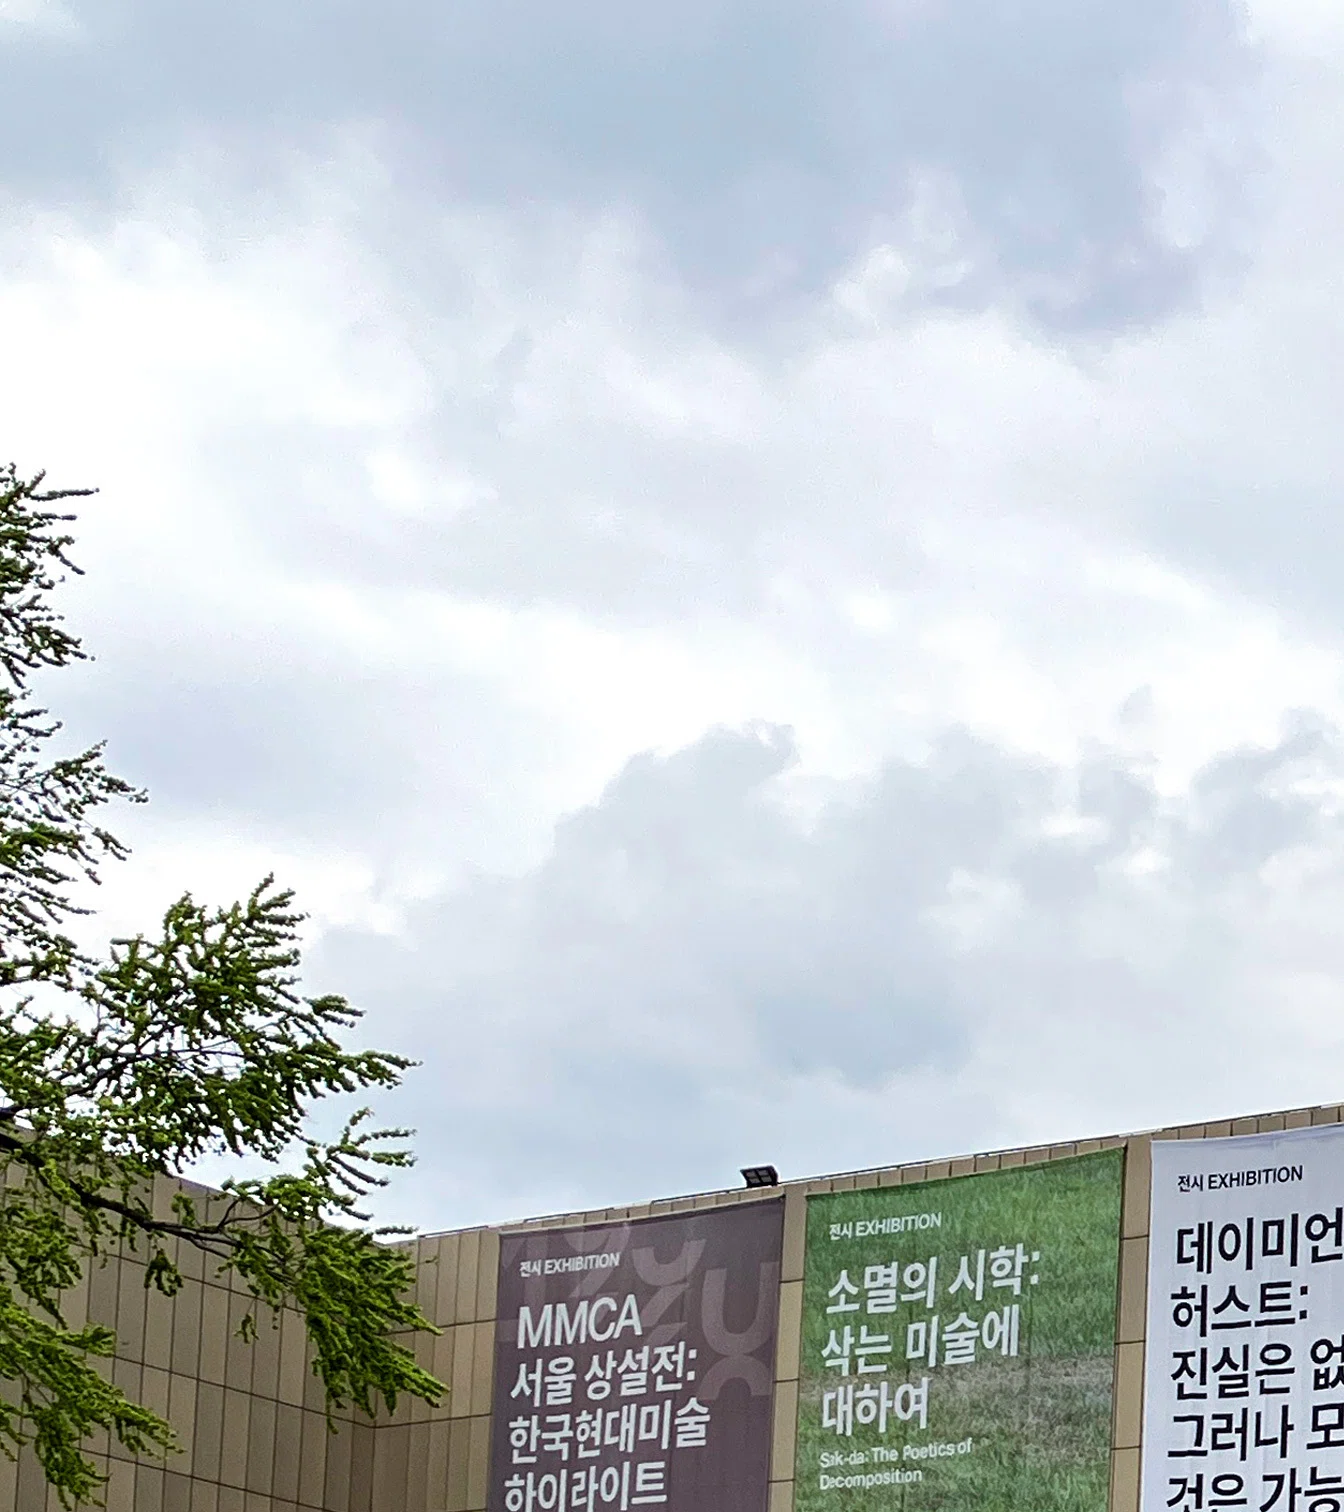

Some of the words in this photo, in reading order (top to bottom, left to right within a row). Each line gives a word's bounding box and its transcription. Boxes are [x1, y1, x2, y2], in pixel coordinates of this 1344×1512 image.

[1178, 1173, 1204, 1192] 전시
[1208, 1166, 1303, 1190] EXHIBITION
[829, 1224, 852, 1241] 전시
[856, 1213, 942, 1237] EXHIBITION
[1177, 1207, 1344, 1274] 데이미언
[520, 1260, 541, 1277] 전시
[544, 1252, 620, 1274] EXHIBITION
[827, 1256, 937, 1315] 소멸의
[948, 1243, 1040, 1300] 시학:
[517, 1293, 643, 1348] MMCA
[1171, 1281, 1308, 1338] 허스트:
[821, 1324, 892, 1376] 삭는
[906, 1305, 1019, 1368] 미술에
[510, 1357, 577, 1407] 서울
[585, 1342, 698, 1399] 상설전:
[1171, 1343, 1295, 1401] 진실은
[509, 1397, 711, 1464] 한국현대미술
[822, 1377, 930, 1436] 대하여
[1167, 1405, 1294, 1461] 그러나
[872, 1447, 898, 1463] The
[902, 1441, 954, 1461] Poetics
[957, 1438, 973, 1455] of
[820, 1469, 922, 1490] Decomposition
